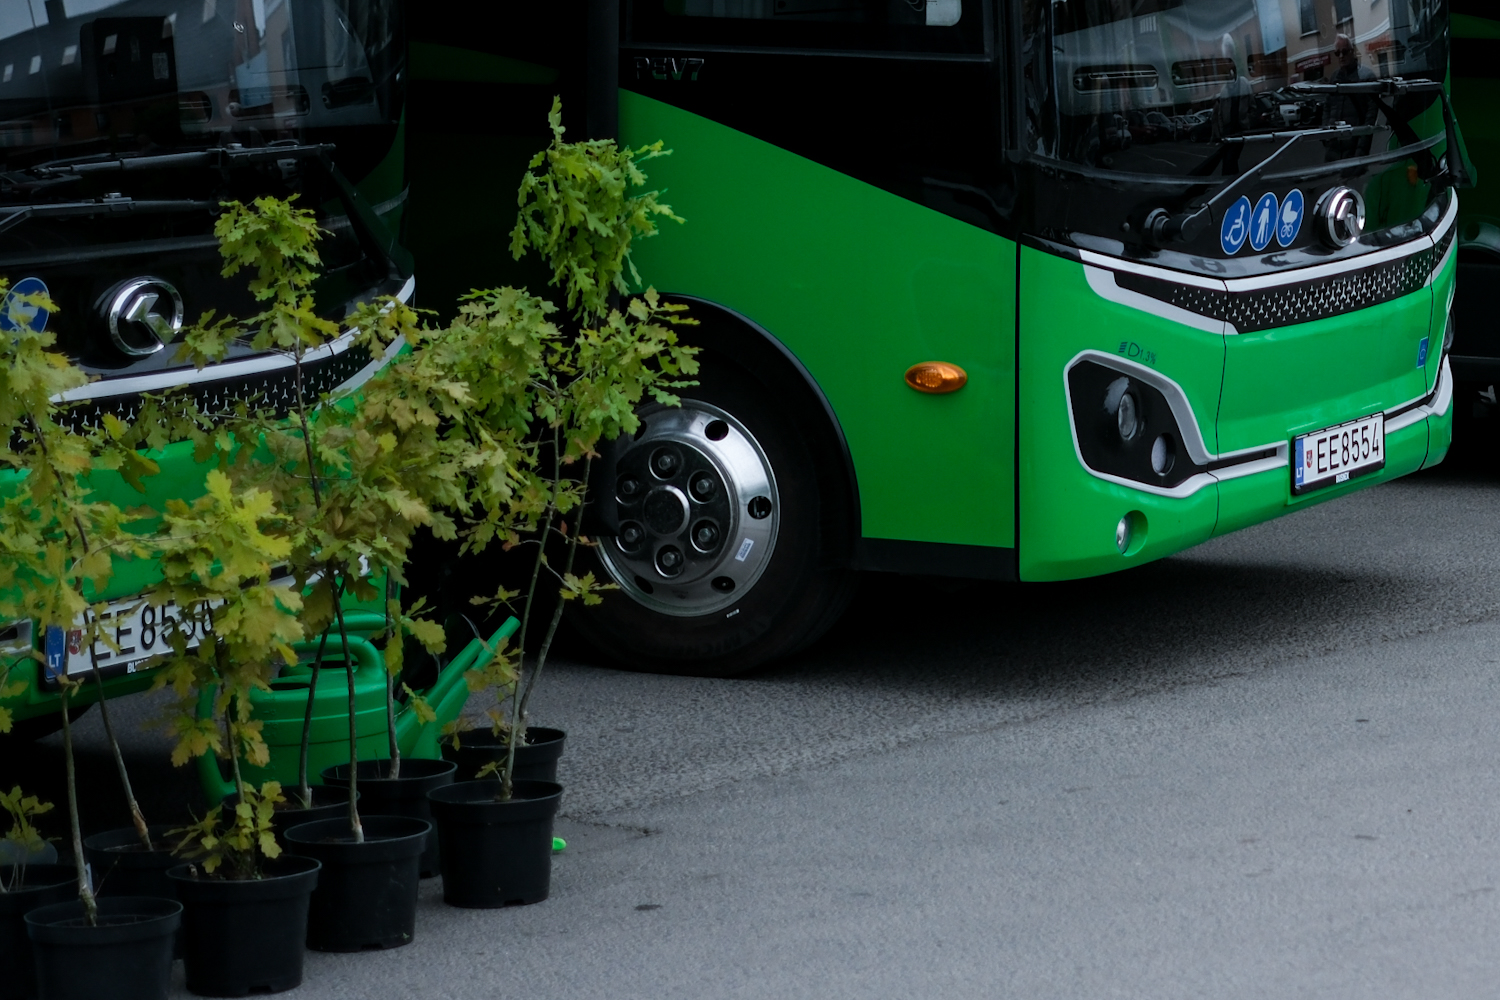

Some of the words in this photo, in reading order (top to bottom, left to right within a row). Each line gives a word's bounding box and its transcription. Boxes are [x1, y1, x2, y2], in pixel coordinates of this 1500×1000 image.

[633, 56, 705, 81] PEV7
[1317, 422, 1380, 474] EE8554
[48, 653, 61, 668] LT
